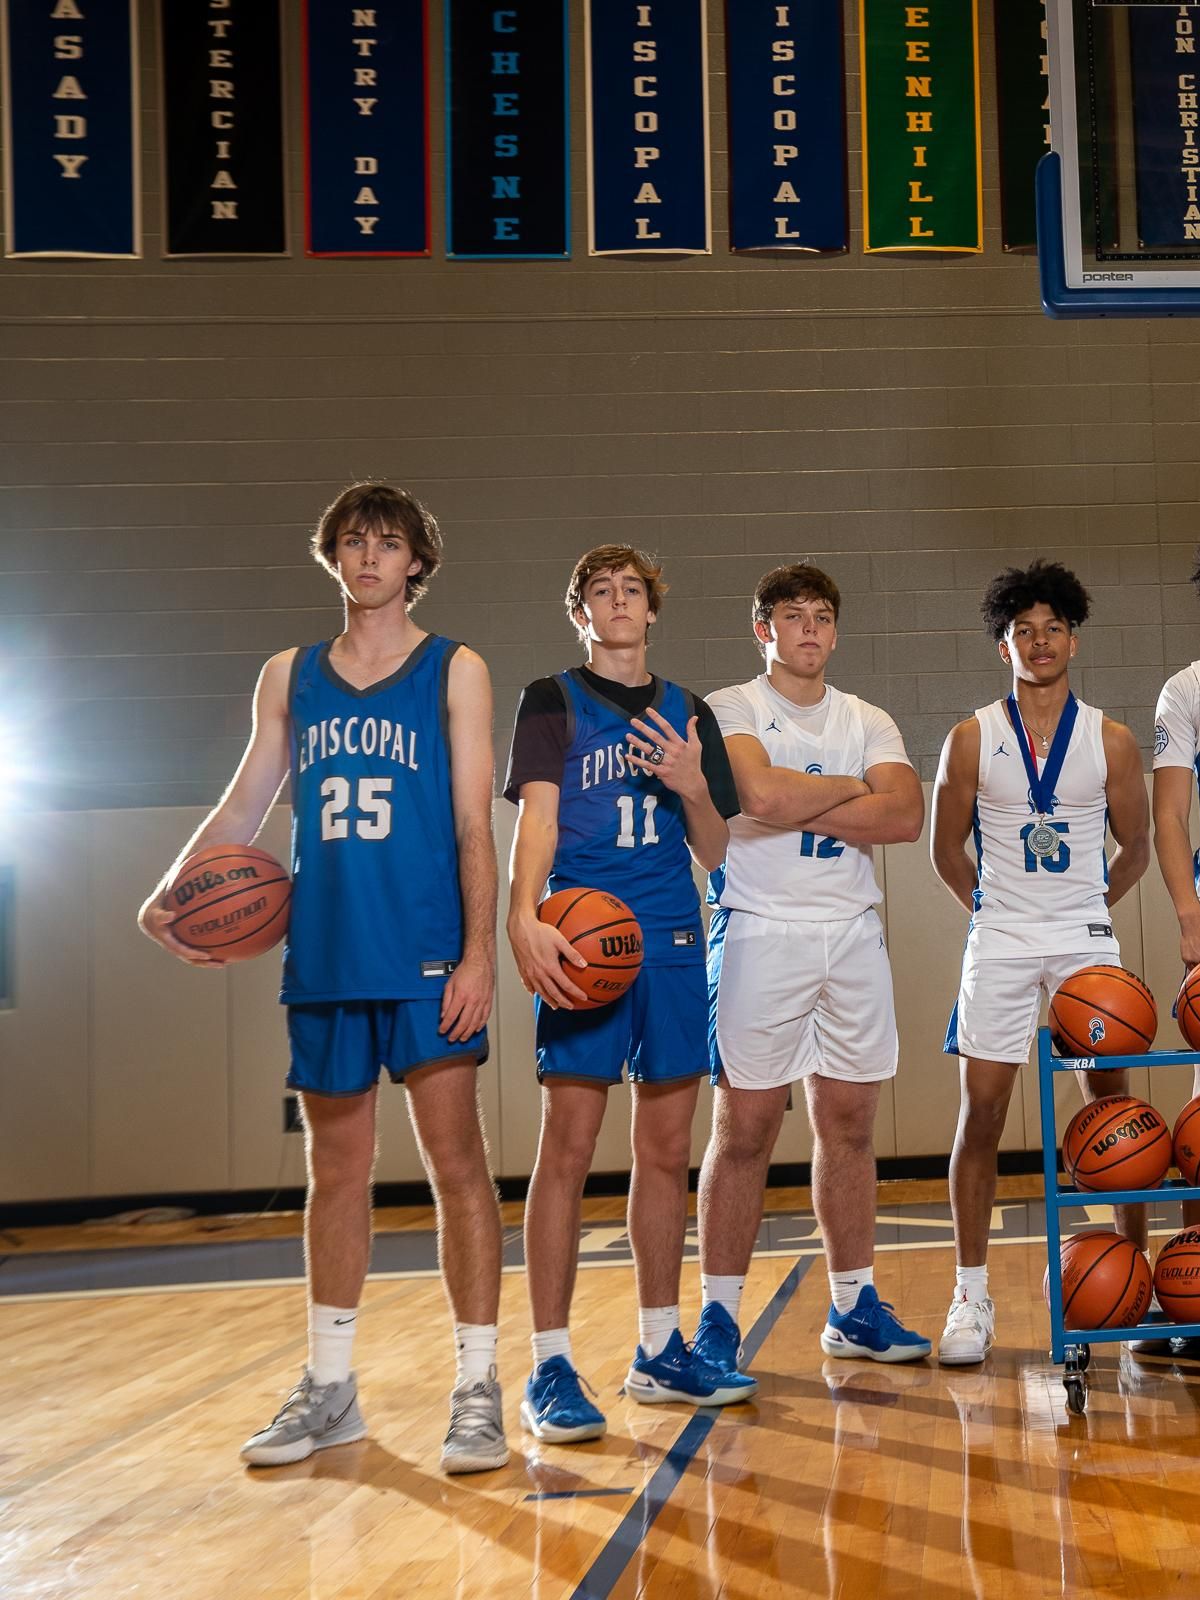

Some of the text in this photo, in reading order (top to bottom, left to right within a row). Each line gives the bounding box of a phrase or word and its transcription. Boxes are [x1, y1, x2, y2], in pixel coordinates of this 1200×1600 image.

[352, 9, 380, 234] NTRY DAY
[491, 10, 521, 240] CHESNE
[633, 6, 661, 239] ISCOPAL
[772, 6, 800, 238] ISCOPAL
[904, 7, 933, 237] EENHILL
[299, 716, 418, 773] EPISCOPAL
[320, 775, 393, 841] 25
[616, 794, 660, 848] 11
[1020, 822, 1071, 873] 15
[175, 865, 261, 906] Wilson
[1073, 1057, 1096, 1069] KBA
[1090, 1111, 1161, 1157] Wilson
